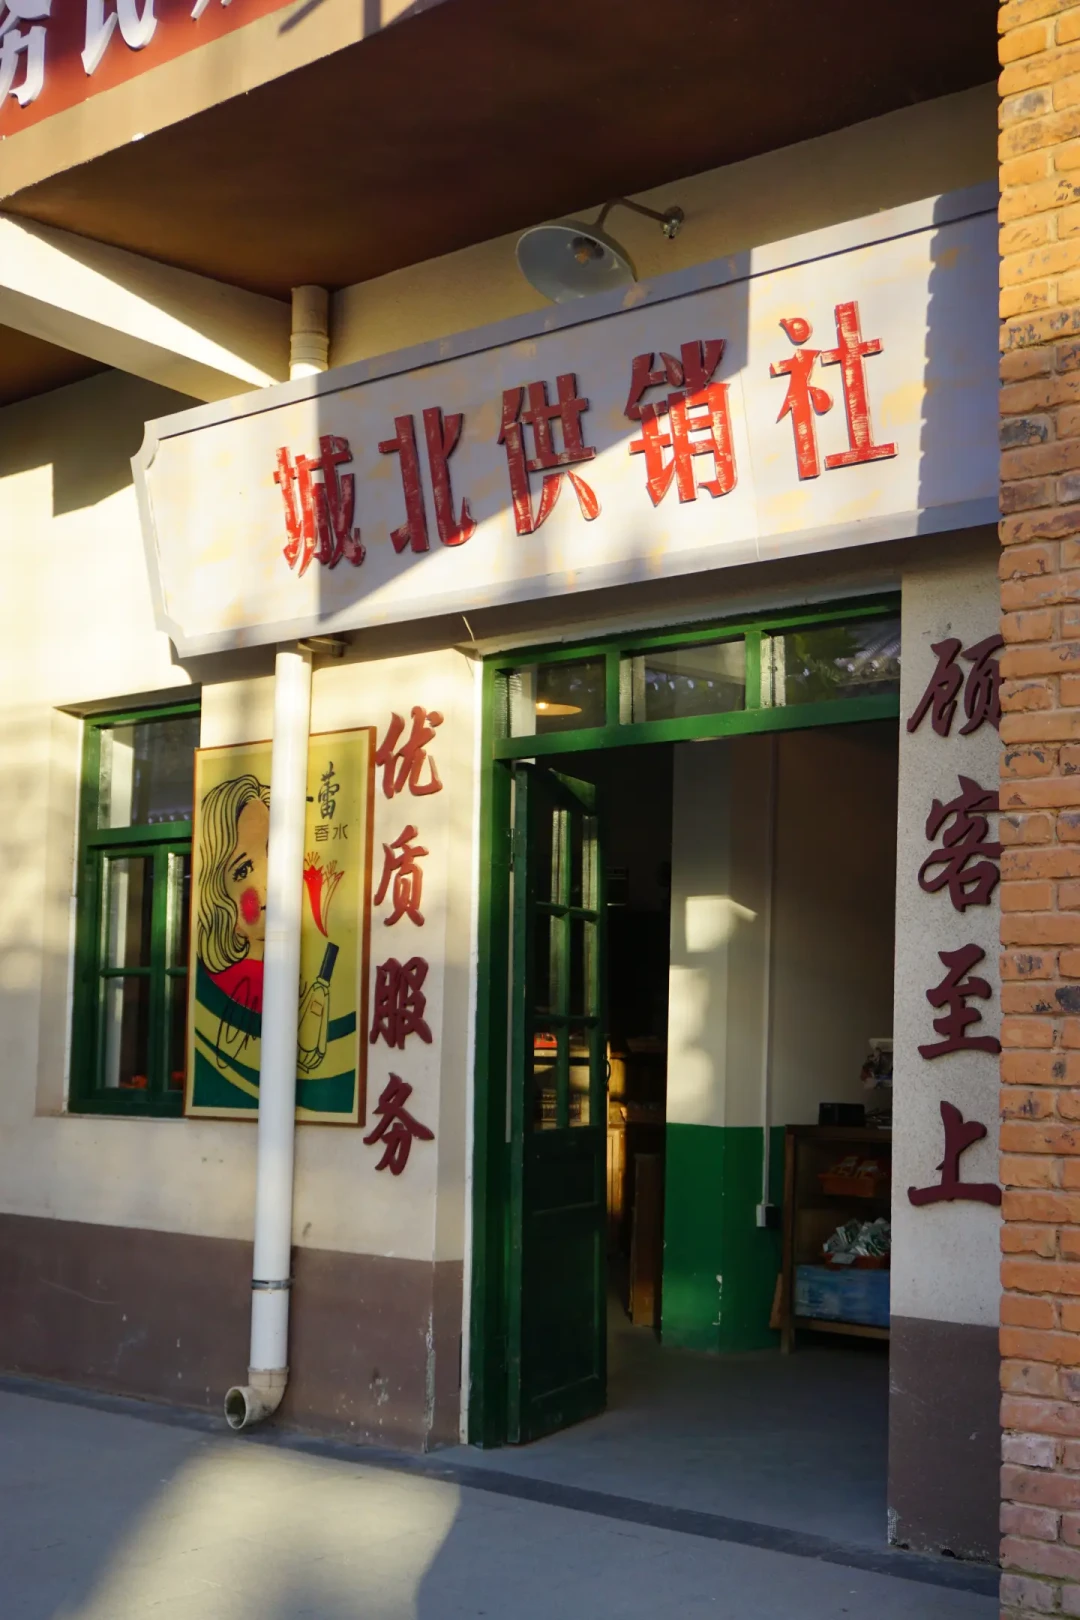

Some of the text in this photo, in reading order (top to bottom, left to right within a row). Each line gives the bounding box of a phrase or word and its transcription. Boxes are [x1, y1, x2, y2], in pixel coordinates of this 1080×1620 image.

[273, 301, 898, 578] 城北供销社
[314, 823, 349, 842] 香水
[363, 705, 444, 1176] 优质服务
[907, 634, 1002, 1205] 顾客至上
